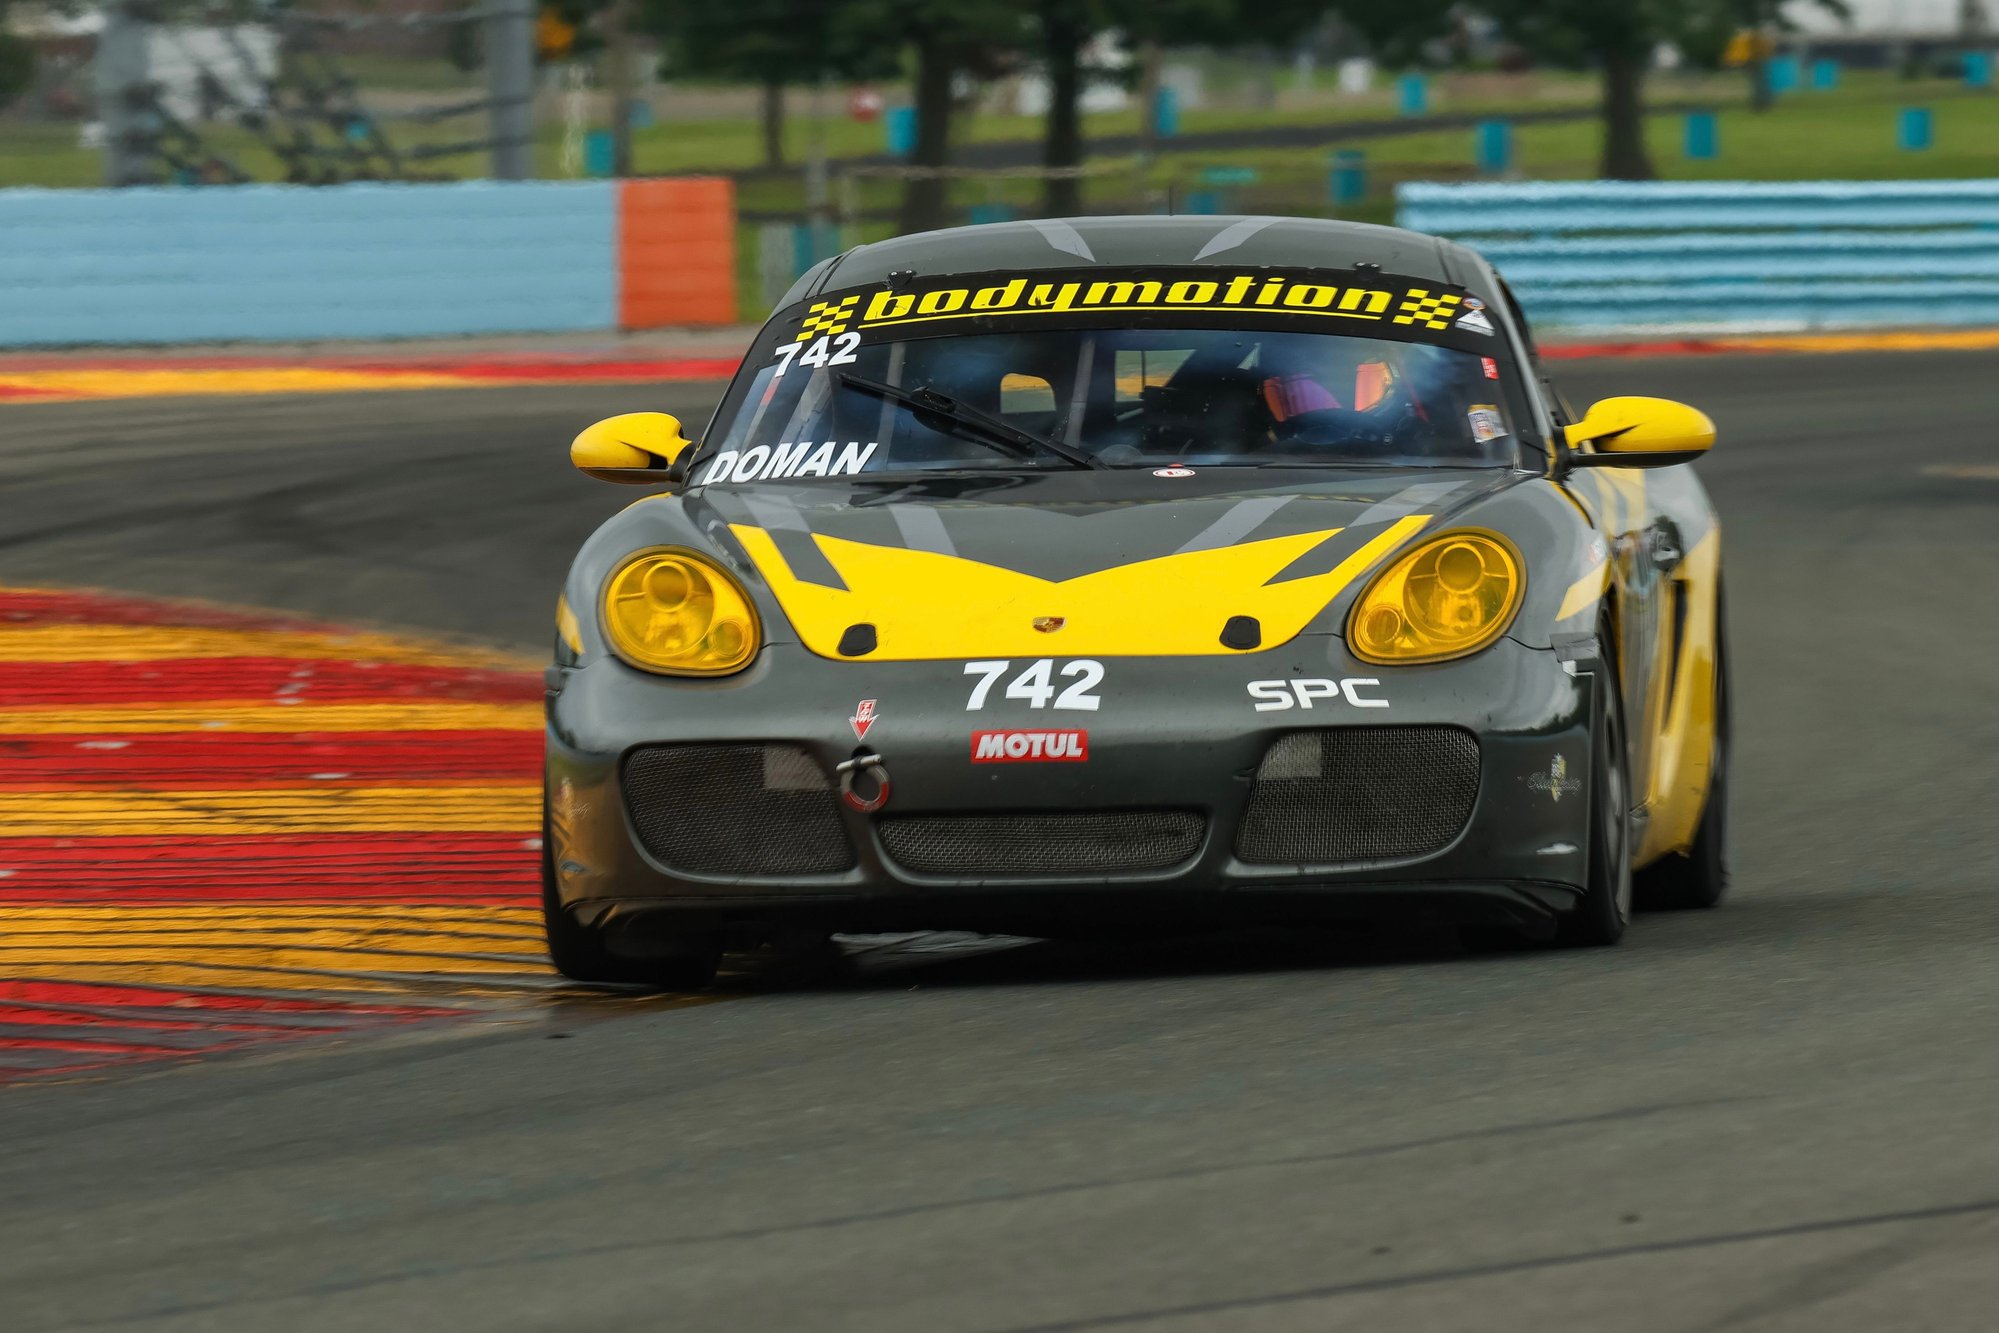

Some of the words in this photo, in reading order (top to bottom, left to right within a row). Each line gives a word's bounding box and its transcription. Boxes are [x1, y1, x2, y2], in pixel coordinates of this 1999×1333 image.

[863, 275, 1393, 321] bodymotion
[774, 331, 862, 378] 742
[701, 441, 878, 486] DOMAN
[963, 658, 1105, 711] 742
[1247, 678, 1390, 712] SPC
[975, 732, 1084, 759] MOTUL
